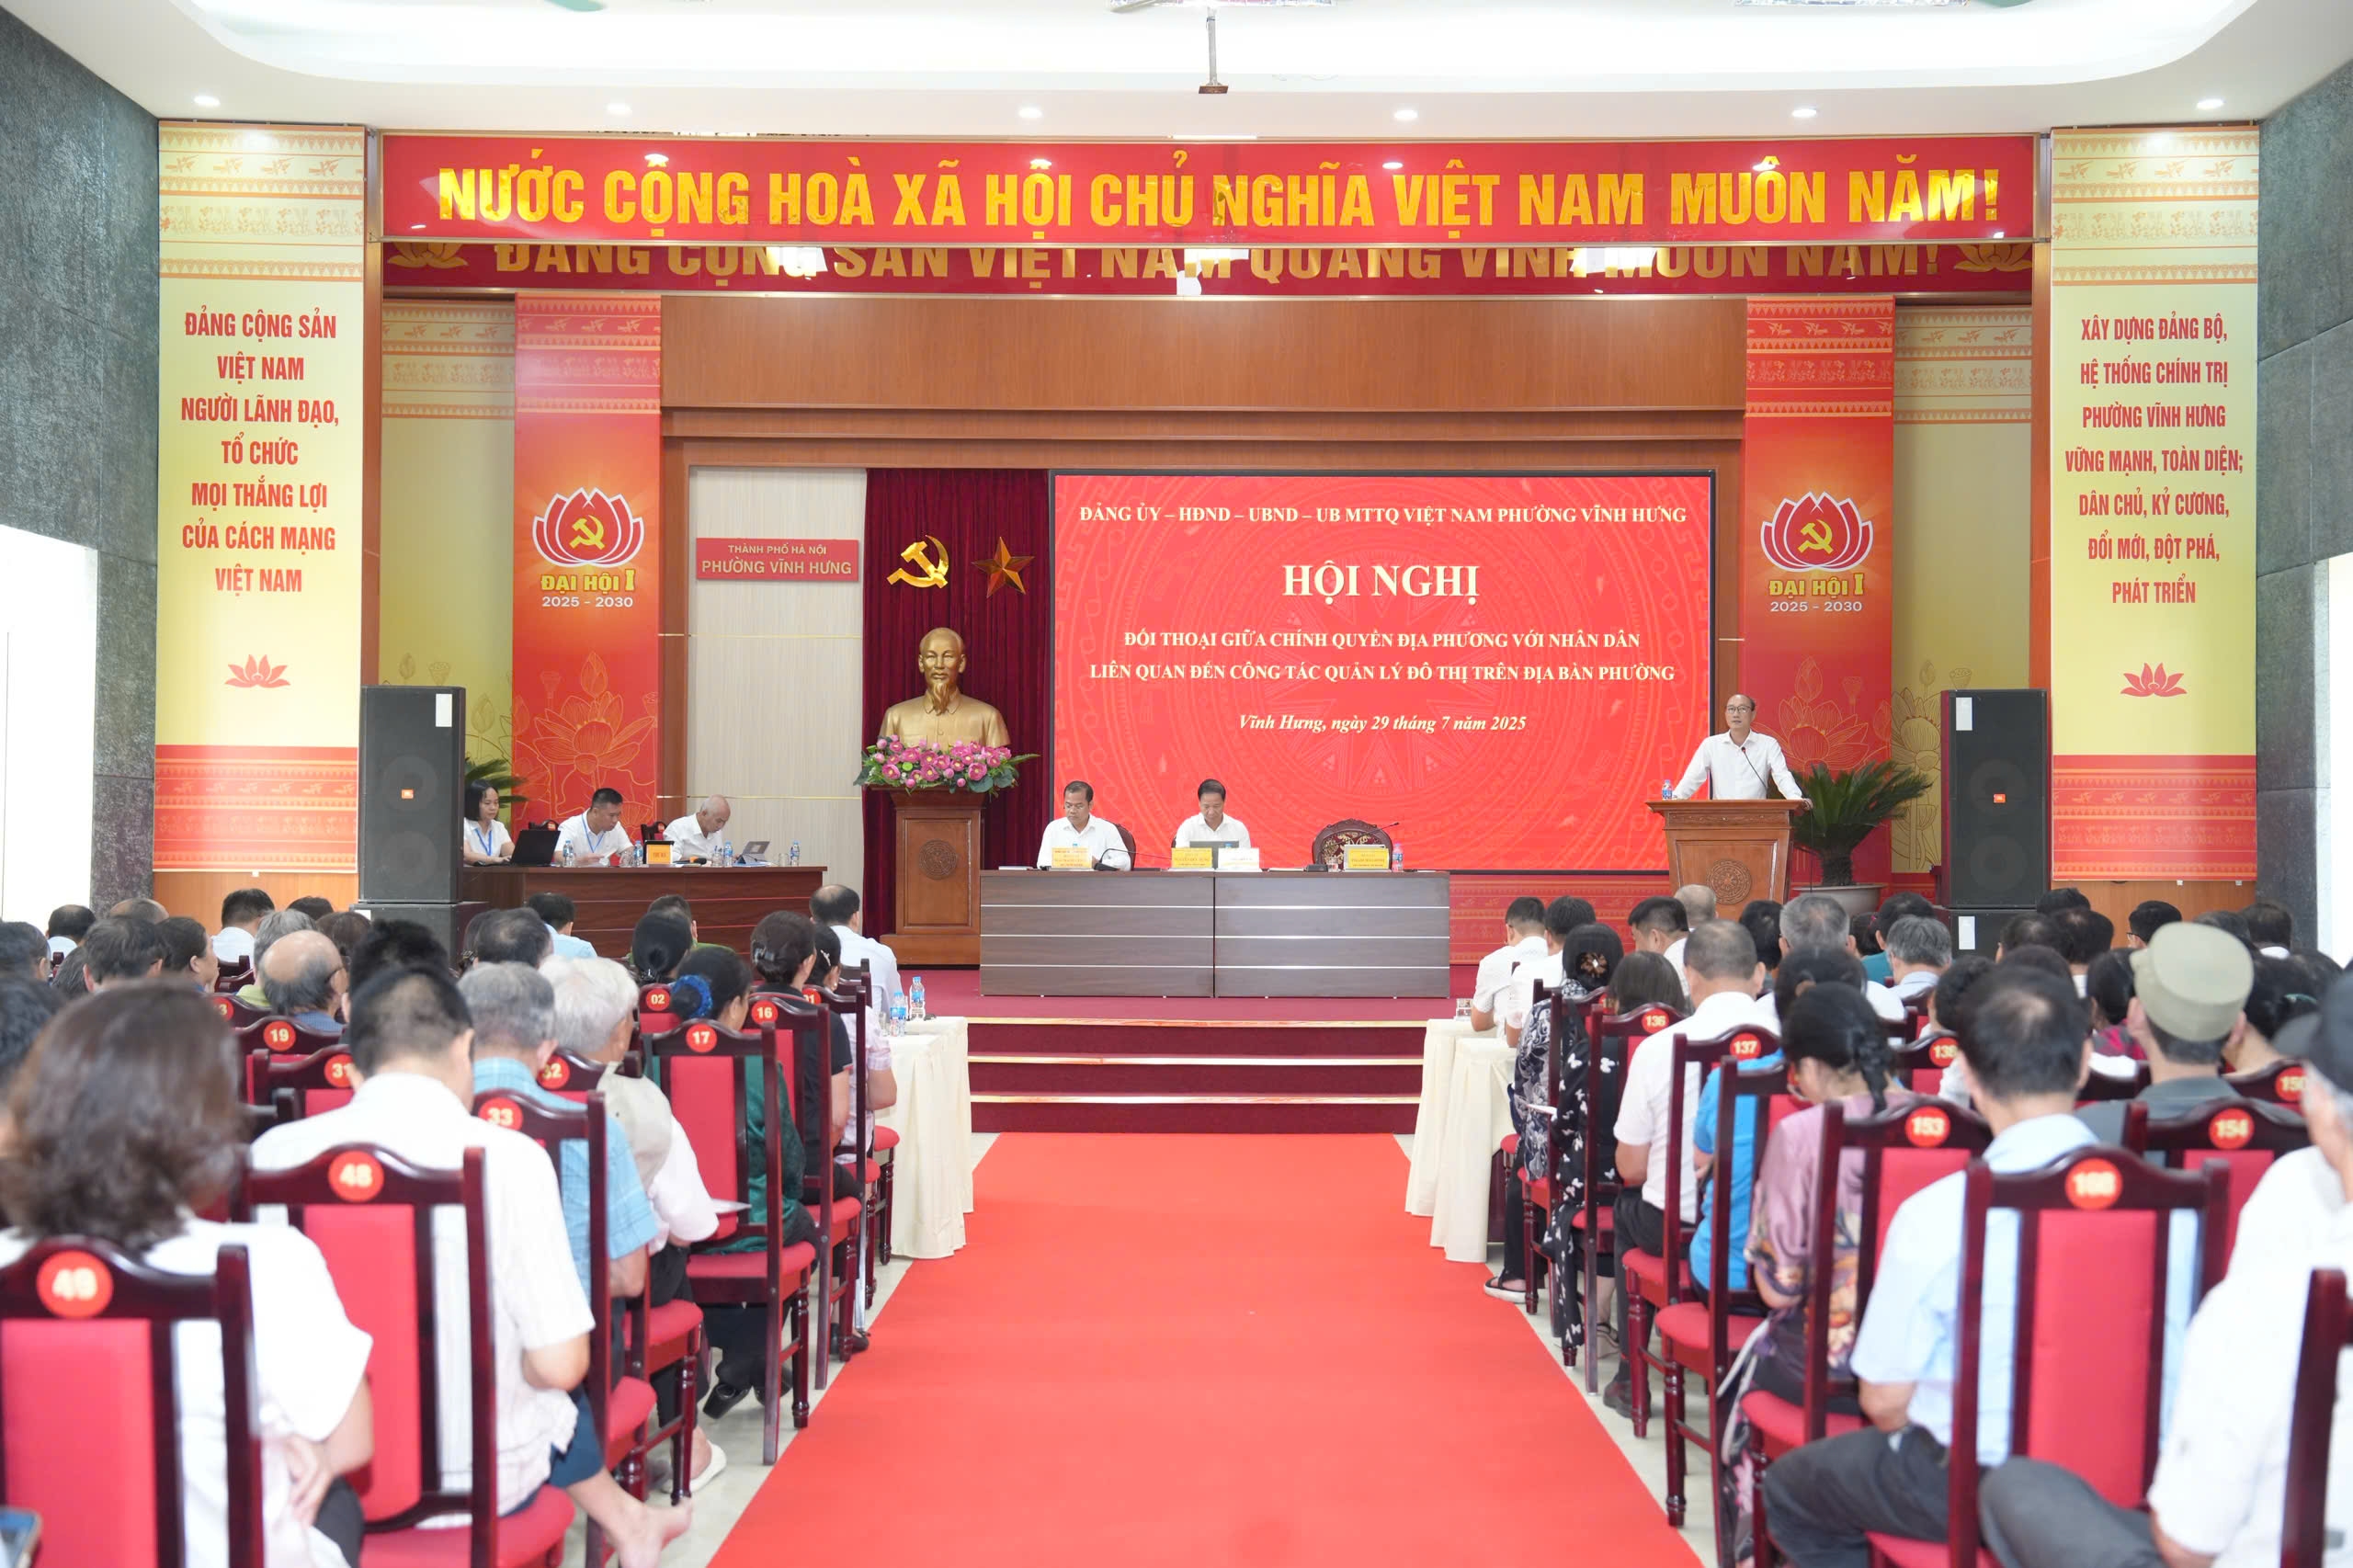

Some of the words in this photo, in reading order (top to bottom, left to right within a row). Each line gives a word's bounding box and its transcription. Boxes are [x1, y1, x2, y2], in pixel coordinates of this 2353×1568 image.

[438, 149, 585, 223] NƯỚC
[604, 153, 750, 237] CỘNG
[769, 155, 875, 225] HOÀ
[892, 159, 967, 226] XÃ
[985, 158, 1073, 239] HỘI
[1090, 150, 1194, 228] CHỦ
[1212, 161, 1375, 227] NGHĨA
[1392, 159, 1500, 239] VIỆT
[1518, 174, 1643, 225] NAM
[1670, 155, 1825, 224] MUÔN
[1848, 153, 2000, 222] NĂM!
[185, 304, 236, 336] ĐẢNG
[243, 309, 292, 342] CỘNG
[299, 307, 336, 338] SẢN
[2081, 314, 2109, 340] XÂY
[2115, 316, 2154, 345] DỰNG
[2159, 311, 2199, 340] ĐẢNG
[2204, 312, 2227, 344] BỘ,
[217, 351, 256, 384] VIỆT
[261, 357, 304, 381] NAM
[2081, 358, 2098, 389] HỆ
[2104, 355, 2151, 384] THỐNG
[2156, 358, 2200, 383] CHÍNH
[2206, 361, 2228, 388] TRỊ
[181, 392, 238, 422] NGƯỜI
[244, 394, 292, 423] LÃNH
[298, 399, 339, 428] ĐẠO,
[2083, 401, 2142, 427] PHƯỜNG
[2147, 402, 2180, 427] VĨNH
[2186, 404, 2225, 427] HƯNG
[222, 431, 244, 464] TỔ
[250, 437, 299, 465] CHỨC
[2065, 446, 2104, 472] VỮNG
[2109, 450, 2157, 477] MẠNH,
[2162, 446, 2200, 472] TOÀN
[2205, 445, 2243, 475] DIỆN;
[192, 483, 226, 511] MỌI
[233, 475, 293, 507] THẮNG
[300, 483, 327, 513] LỢI
[2079, 490, 2109, 516] DÂN
[2114, 486, 2147, 518] CHỦ,
[2152, 486, 2170, 516] KỶ
[2175, 491, 2229, 517] CƯƠNG,
[1079, 503, 1132, 521] ĐẢNG
[1137, 503, 1162, 521] ỦY
[1179, 507, 1231, 521] HĐND
[1249, 508, 1299, 522] UBND
[1316, 508, 1341, 522] UB
[1346, 508, 1399, 525] MTTQ
[1404, 506, 1447, 526] VIỆT
[1451, 508, 1493, 522] NAM
[1497, 505, 1576, 523] PHƯỜNG
[1581, 505, 1627, 523] VĨNH
[1631, 506, 1687, 523] HƯNG
[182, 517, 219, 549] CỦA
[225, 520, 274, 550] CÁCH
[281, 527, 335, 555] MẠNG
[728, 543, 764, 553] THÀNH
[767, 542, 789, 554] PHỐ
[791, 544, 806, 554] HÀ
[809, 544, 826, 555] NỘI
[2088, 528, 2112, 560] ĐỔI
[2118, 533, 2149, 562] MỚI,
[2154, 533, 2182, 564] ĐỘT
[2186, 533, 2220, 562] PHÁ,
[702, 556, 765, 573] PHƯỜNG
[770, 558, 804, 574] VĨNH
[810, 561, 852, 574] HƯNG
[215, 563, 254, 597] VIỆT
[259, 568, 302, 592] NAM
[541, 574, 576, 594] ĐẠI
[584, 573, 620, 595] HỘI
[625, 569, 635, 591] I
[1282, 560, 1360, 605] HỘI
[1372, 565, 1480, 606] NGHỊ
[1769, 580, 1804, 598] ĐẠI
[1812, 577, 1848, 598] HỘI
[1854, 574, 1864, 596] I
[2112, 577, 2149, 603] PHÁT
[2154, 573, 2196, 604] TRIỂN
[542, 597, 580, 608] 2025
[596, 597, 633, 608] 2030
[1770, 601, 1808, 612] 2025
[1824, 601, 1862, 612] 2030
[1125, 628, 1156, 647] ĐỐI
[1160, 632, 1216, 650] THOẠI
[1221, 630, 1267, 647] GIỮA
[1269, 630, 1327, 647] CHÍNH
[1398, 634, 1427, 651] ĐỊA
[1432, 632, 1508, 648] PHƯƠNG
[1512, 630, 1544, 647] VỚI
[1549, 630, 1600, 647] NHÂN
[1604, 630, 1640, 647] DÂN
[1090, 662, 1131, 678] LIÊN
[1135, 665, 1185, 682] QUAN
[1190, 661, 1226, 679] ĐẾN
[1229, 662, 1280, 680] CÔNG
[1285, 662, 1321, 680] TÁC
[1324, 662, 1375, 682] QUẢN
[1381, 662, 1404, 680] LÝ
[1407, 662, 1433, 680] ĐÔ
[1437, 666, 1468, 683] THỊ
[1472, 662, 1518, 680] TRÊN
[1524, 666, 1554, 683] ĐỊA
[1558, 662, 1594, 680] BÀN
[1598, 664, 1675, 680] PHƯỜNG
[1240, 714, 1275, 729] Vĩnh
[1279, 715, 1326, 733] Hưng,
[1331, 716, 1368, 733] ngày
[1370, 716, 1389, 731] 29
[1392, 715, 1437, 733] tháng
[1442, 717, 1449, 731] 7
[1453, 716, 1486, 731] năm
[1490, 716, 1527, 731] 2025
[651, 994, 665, 1004] 02
[757, 1007, 772, 1018] 16
[1645, 1016, 1665, 1027] 136
[270, 1028, 290, 1042] 19
[692, 1031, 710, 1044] 17
[1733, 1040, 1757, 1054] 137
[543, 1062, 563, 1079] 32
[339, 1163, 372, 1187] 48
[51, 1267, 97, 1301] 49
